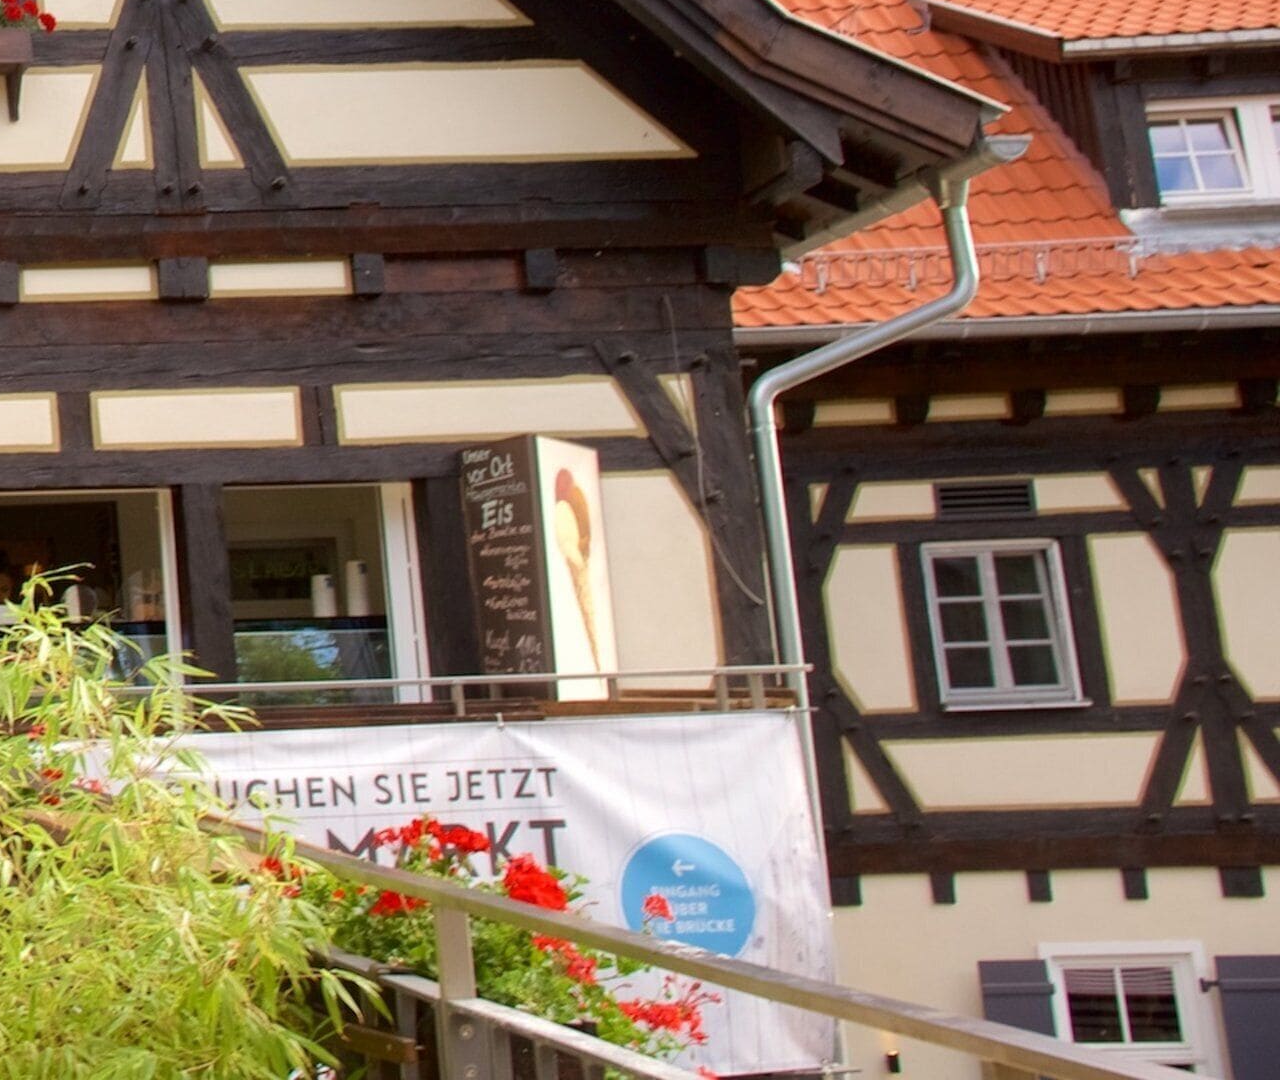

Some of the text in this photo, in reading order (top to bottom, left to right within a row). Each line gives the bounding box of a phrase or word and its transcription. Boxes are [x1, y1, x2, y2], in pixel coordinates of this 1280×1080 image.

[481, 499, 514, 530] Eis
[374, 772, 431, 806] SIE
[448, 767, 559, 801] JETZT
